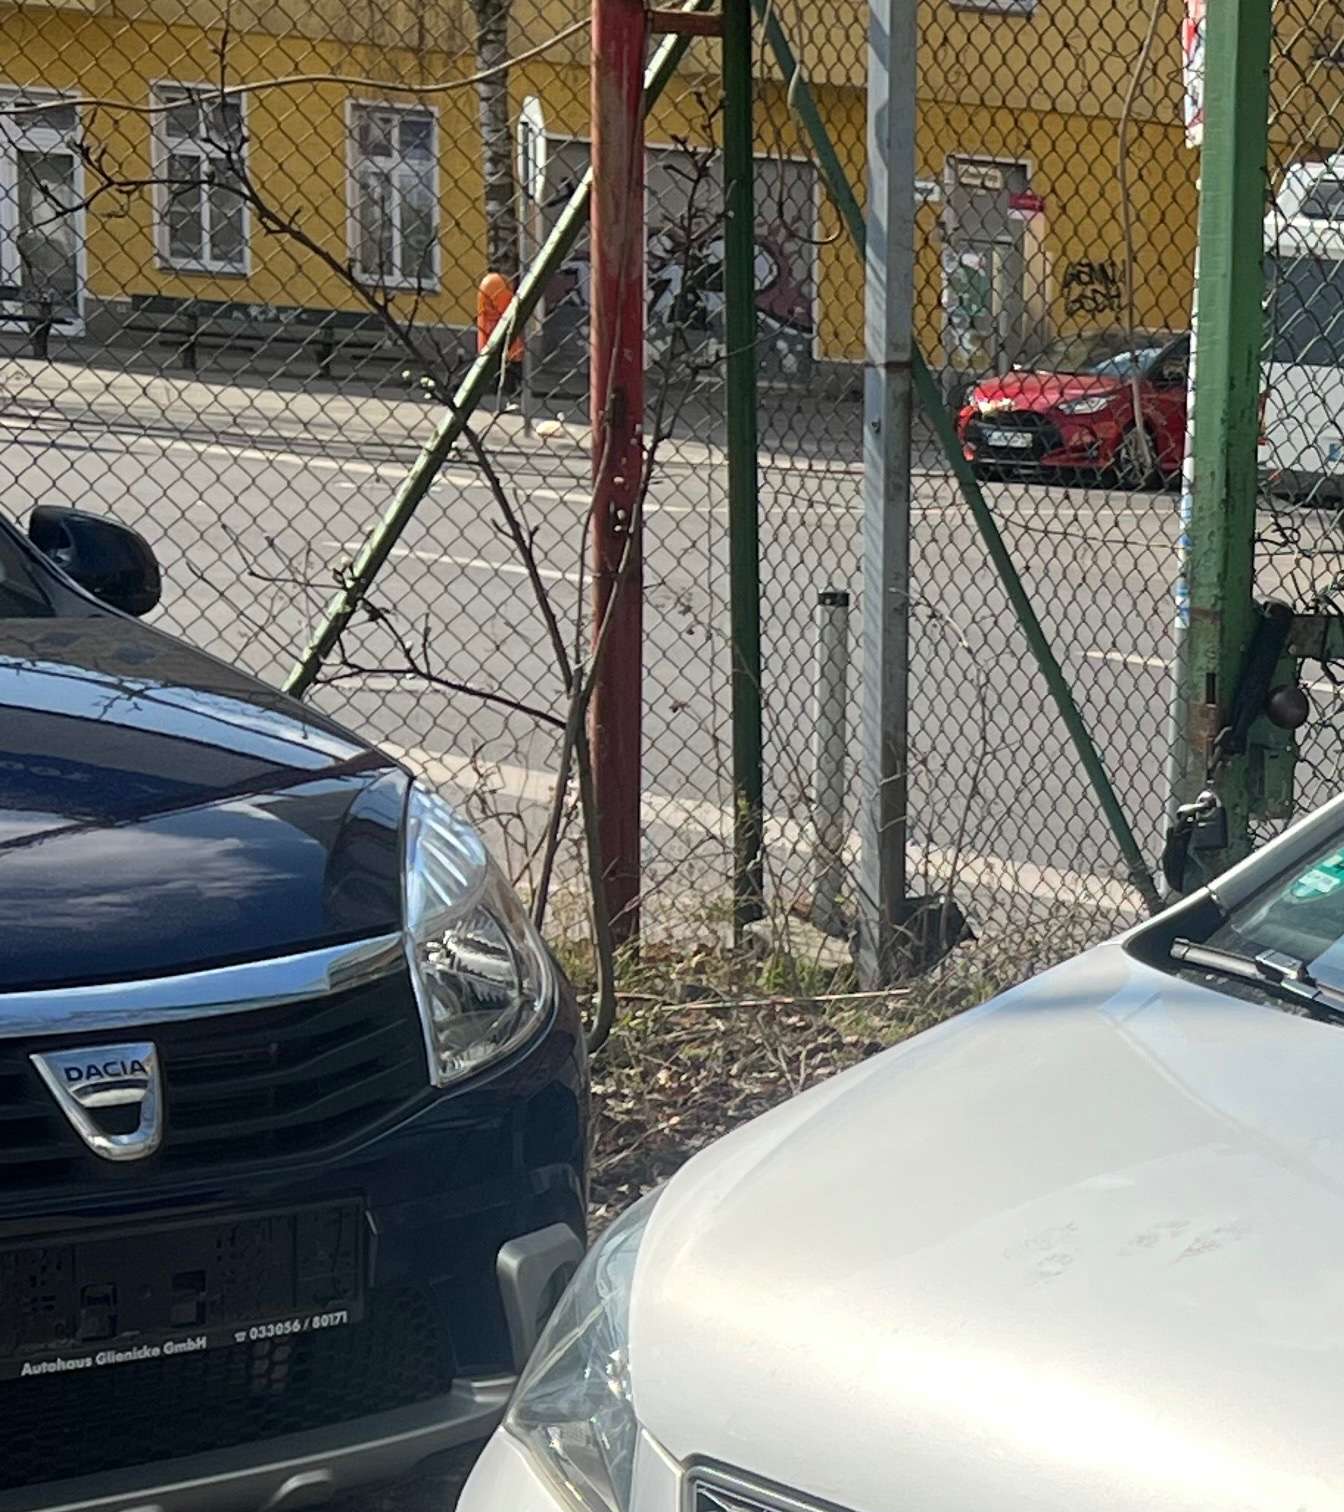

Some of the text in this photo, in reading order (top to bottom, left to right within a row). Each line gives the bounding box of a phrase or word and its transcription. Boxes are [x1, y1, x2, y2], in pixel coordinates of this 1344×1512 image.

[63, 1059, 148, 1082] DACIA
[20, 1357, 92, 1376] Autohaus
[95, 1344, 161, 1366] Glienicke
[163, 1336, 207, 1355] GmbH
[249, 1318, 301, 1340] 033056
